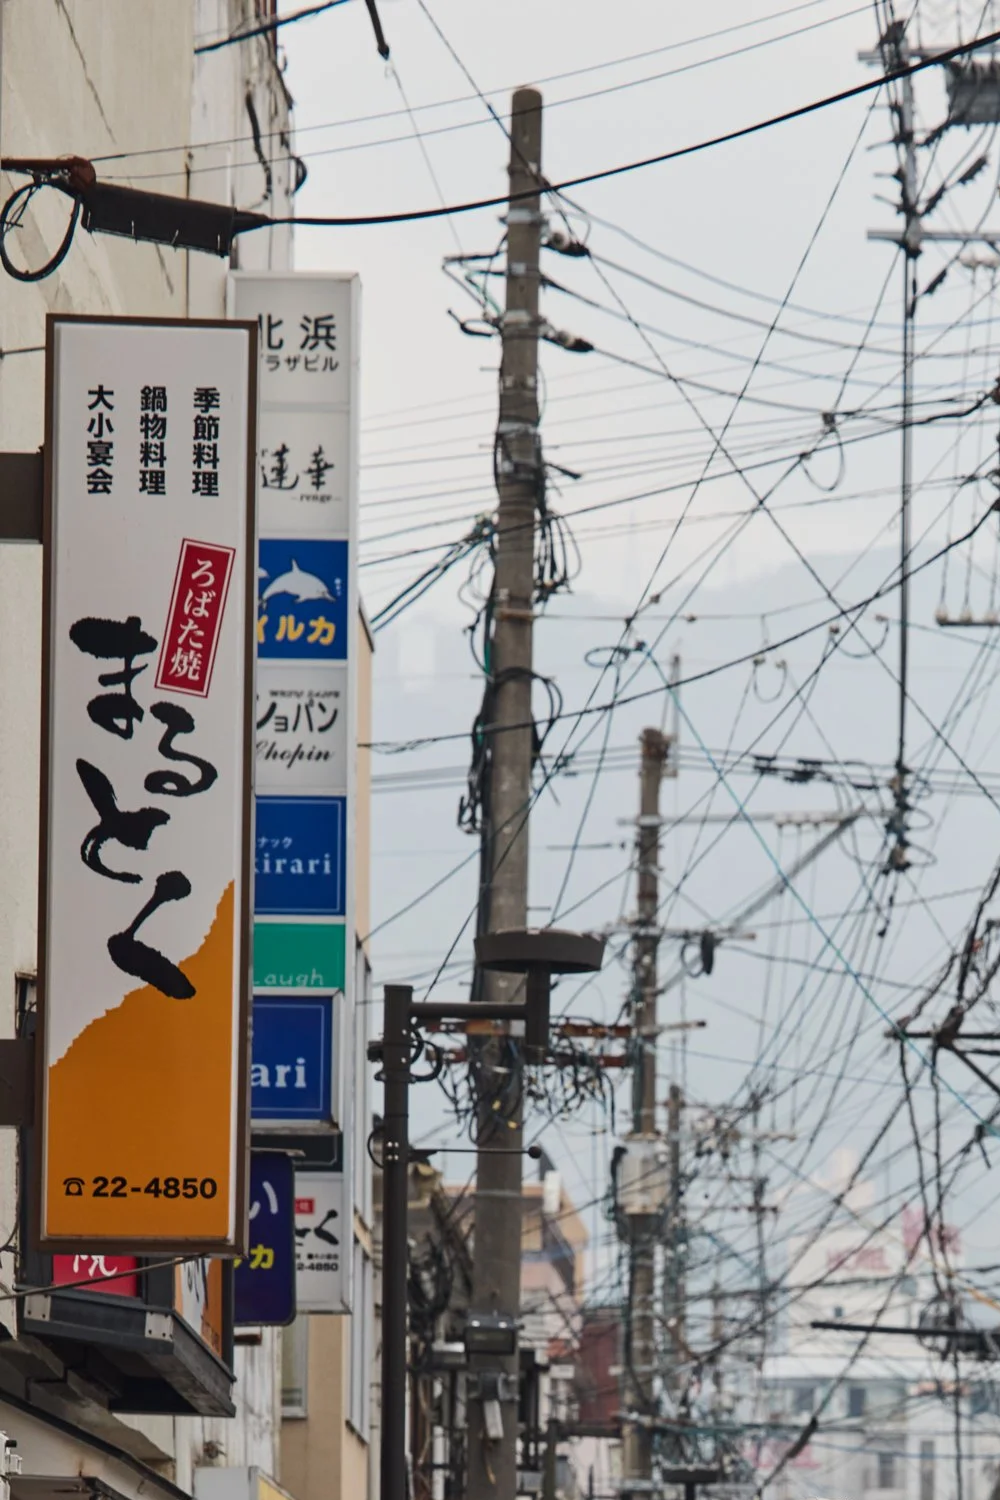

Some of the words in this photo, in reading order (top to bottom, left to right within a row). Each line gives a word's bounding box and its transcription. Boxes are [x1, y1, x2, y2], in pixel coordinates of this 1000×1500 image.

[260, 354, 339, 372] ラザビル
[86, 384, 115, 495] 大小宴会
[139, 385, 168, 496] 鍋物料理
[192, 386, 220, 497] 季節料理
[168, 558, 217, 682] ろばた焼
[68, 615, 219, 1000] まるとく
[256, 836, 293, 849] ナック
[91, 1176, 218, 1200] 22-4850
